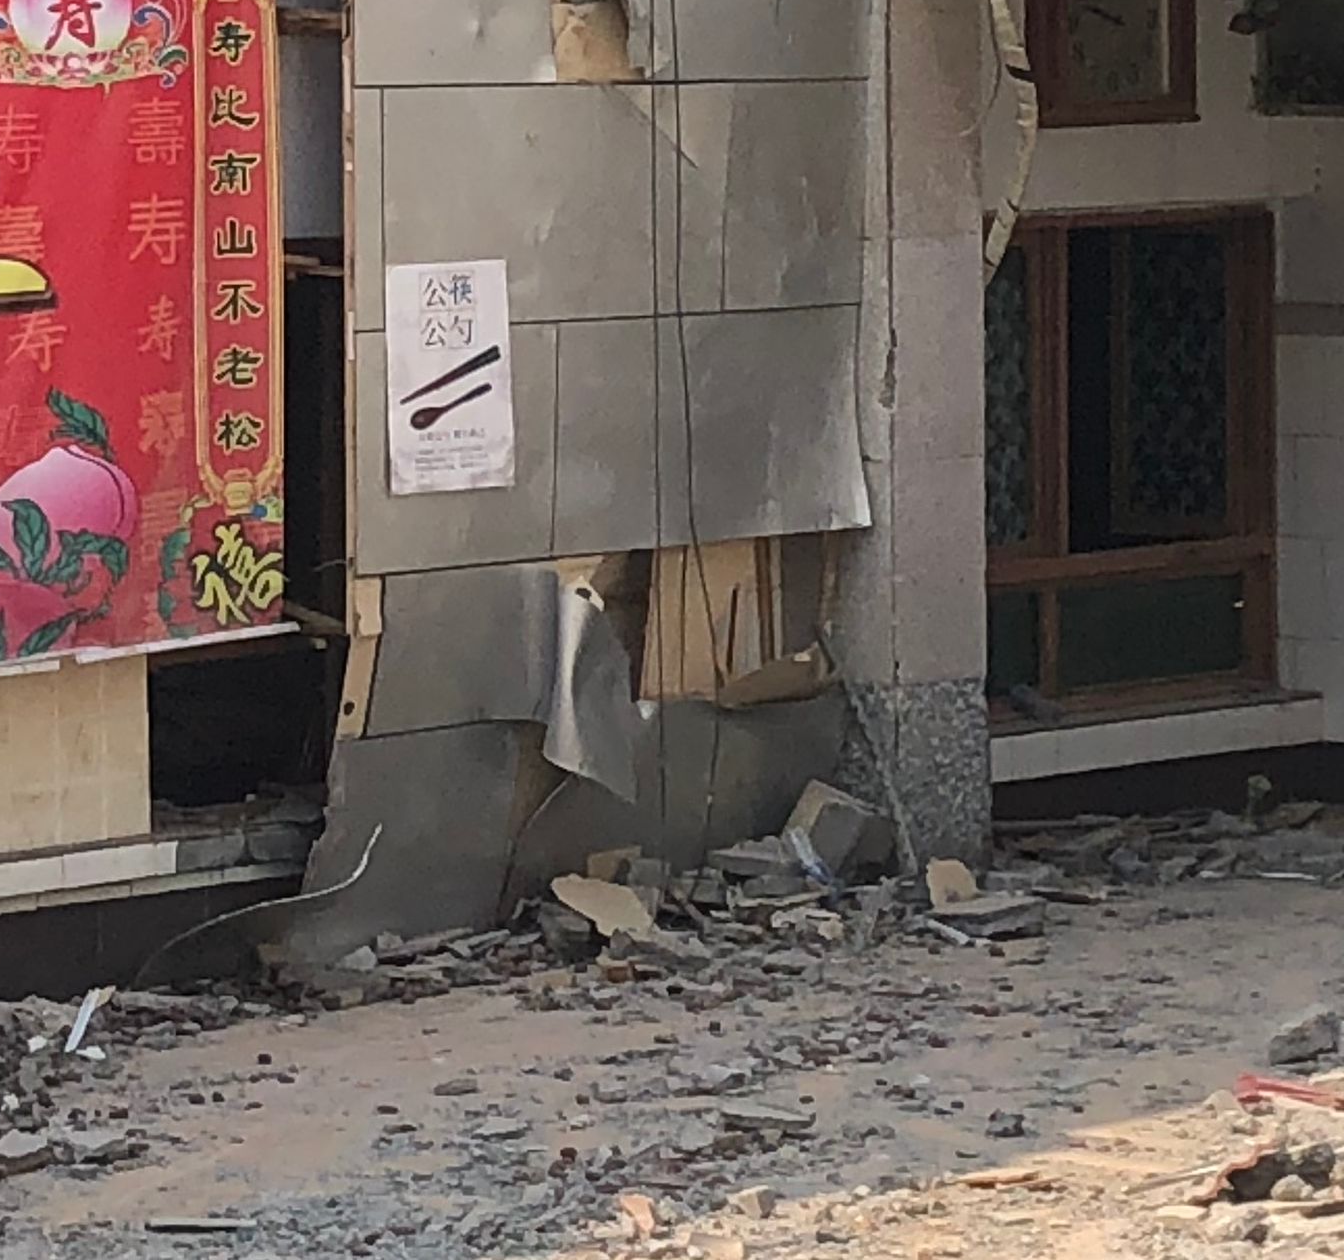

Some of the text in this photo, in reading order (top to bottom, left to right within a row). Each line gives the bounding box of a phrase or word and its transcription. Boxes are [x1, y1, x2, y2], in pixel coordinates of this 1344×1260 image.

[208, 22, 264, 453] 寿比南山不老松
[420, 316, 473, 347] 公勺
